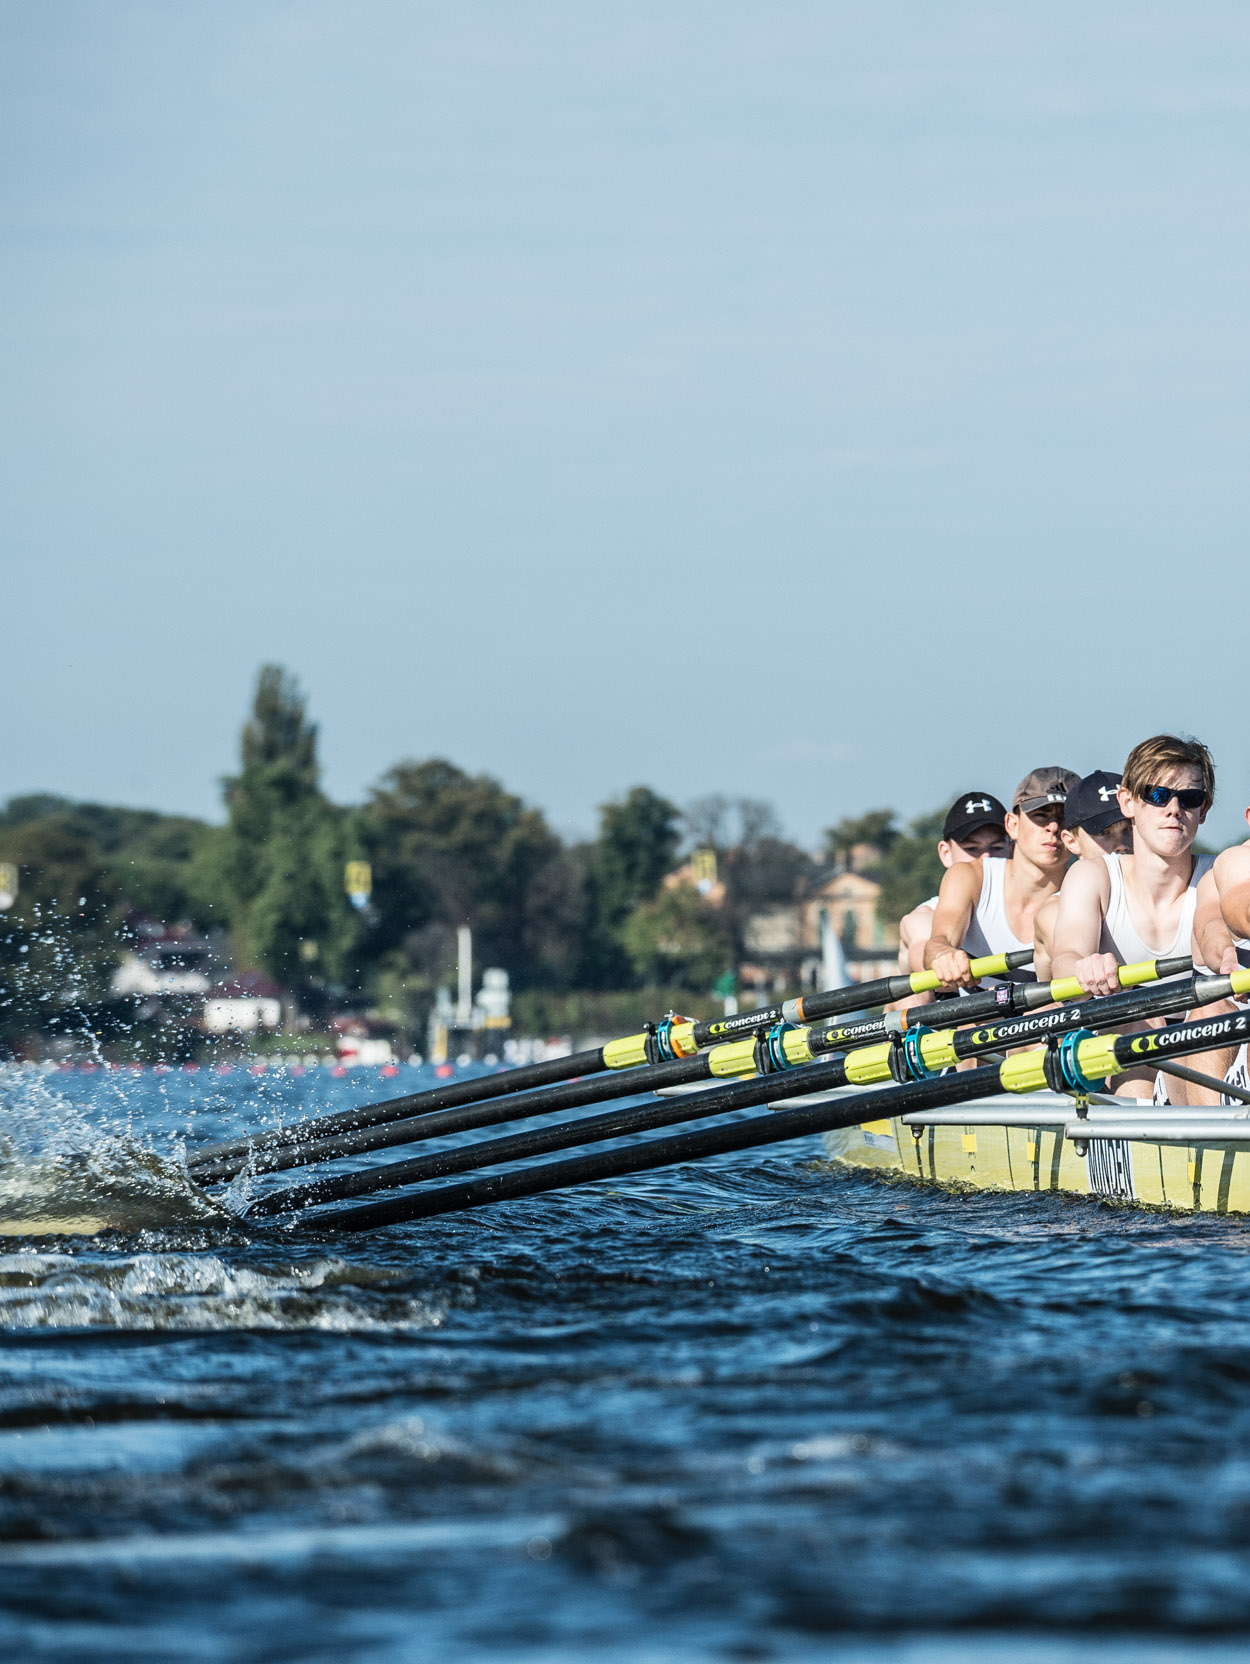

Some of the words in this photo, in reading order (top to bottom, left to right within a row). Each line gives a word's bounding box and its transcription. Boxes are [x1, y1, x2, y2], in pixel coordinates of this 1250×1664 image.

[724, 1012, 770, 1029] concept
[769, 1010, 776, 1018] 2
[843, 1020, 886, 1036] concep
[997, 1012, 1066, 1037] concept
[1070, 1008, 1080, 1020] 2
[1158, 1019, 1231, 1046] concept
[1235, 1016, 1246, 1030] 2
